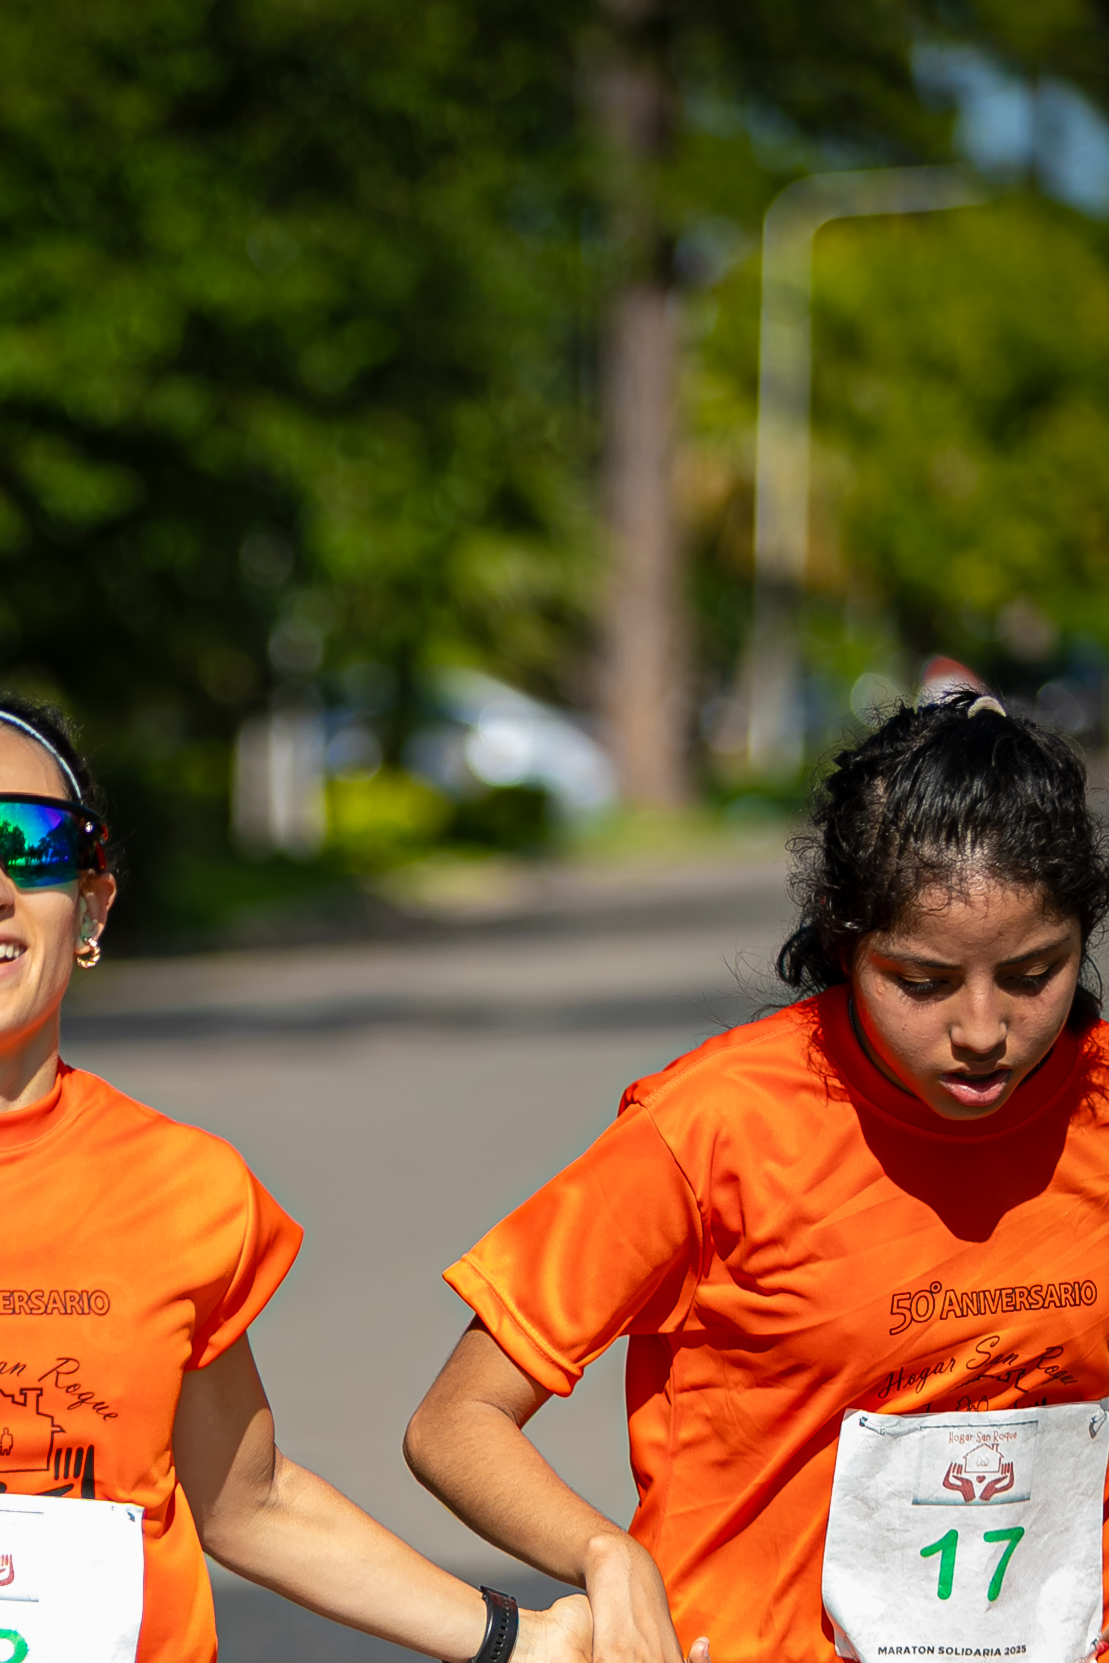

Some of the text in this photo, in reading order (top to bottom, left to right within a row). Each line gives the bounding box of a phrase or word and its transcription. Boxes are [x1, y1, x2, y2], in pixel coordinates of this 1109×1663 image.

[939, 1280, 1098, 1320] ANIVERSARIO
[38, 1357, 118, 1421] Roque
[877, 1356, 956, 1399] Hogar
[949, 1431, 1018, 1444] Hogar San Roque
[920, 1526, 1025, 1602] 17
[877, 1644, 1027, 1657] MARATON SOLIDARIA 2025
